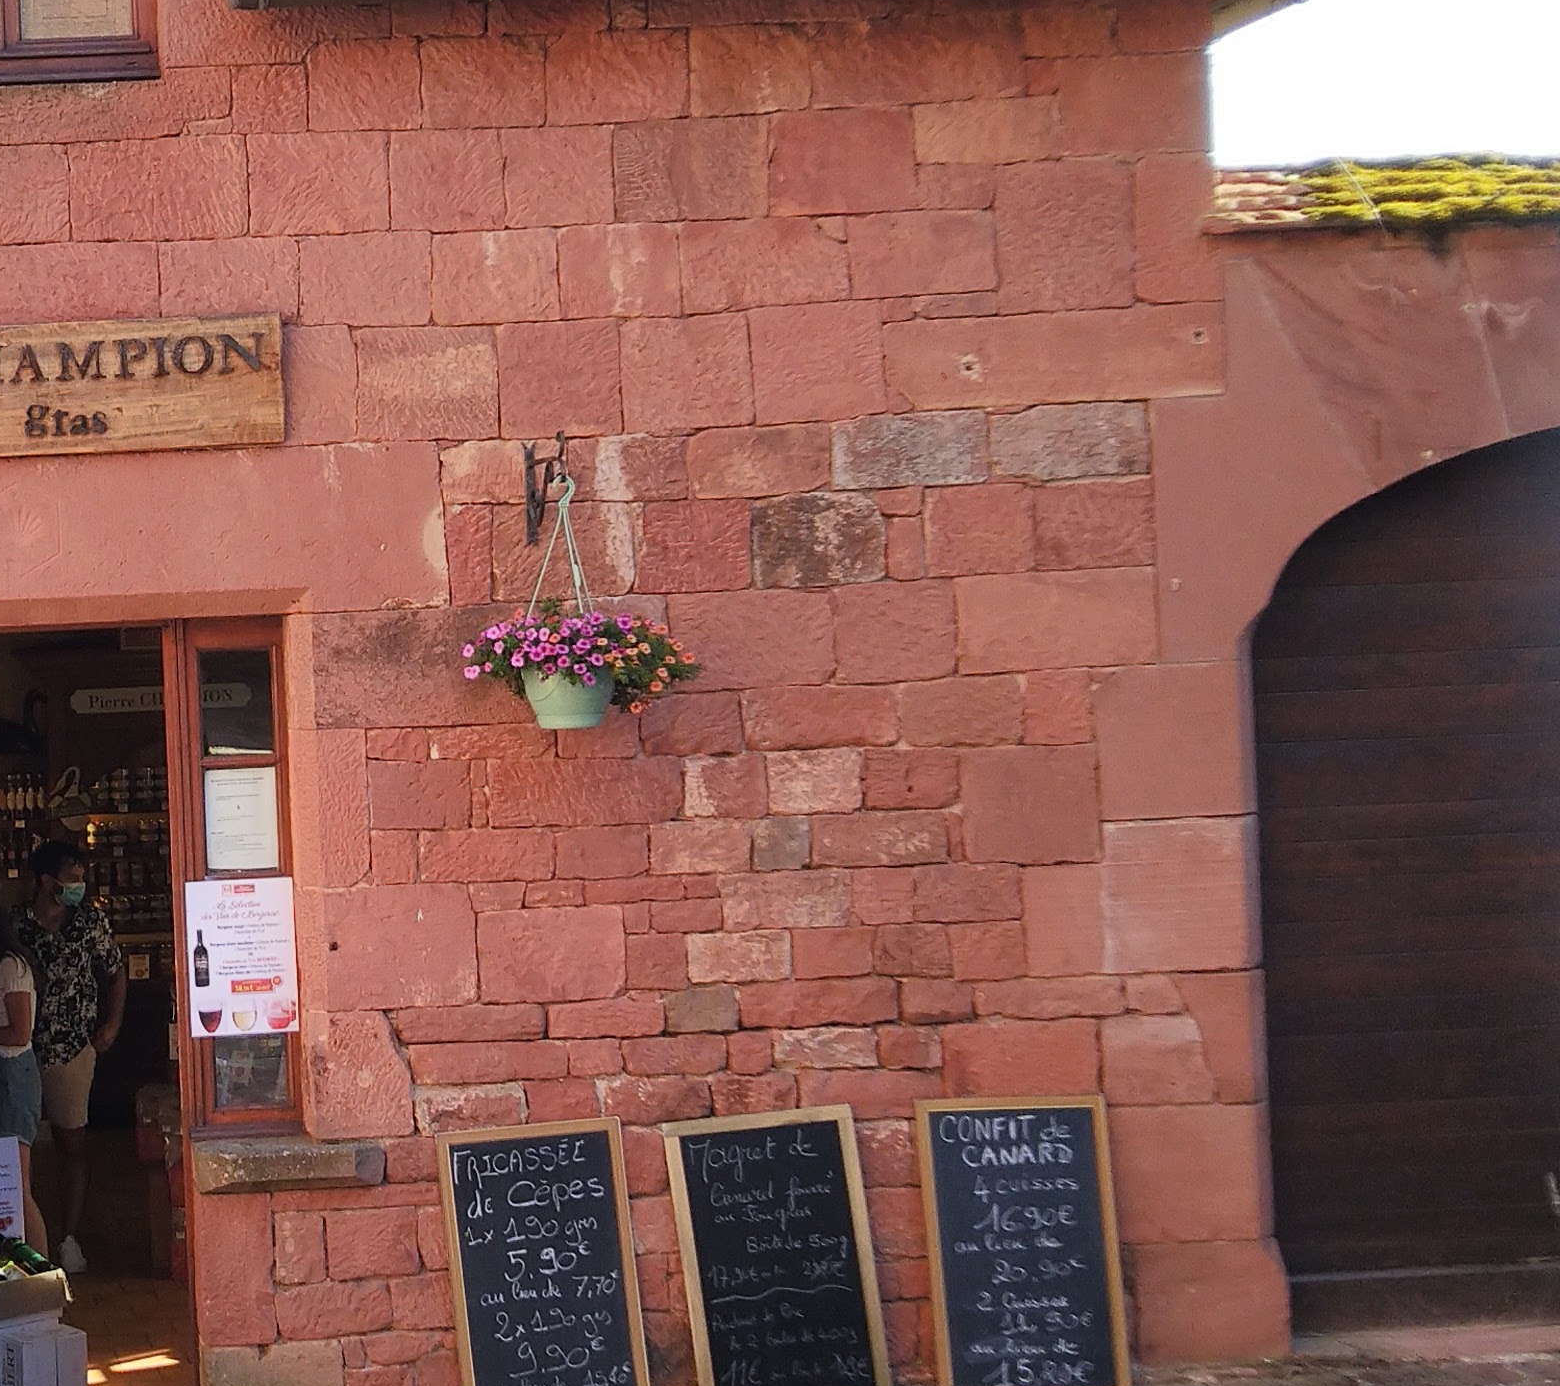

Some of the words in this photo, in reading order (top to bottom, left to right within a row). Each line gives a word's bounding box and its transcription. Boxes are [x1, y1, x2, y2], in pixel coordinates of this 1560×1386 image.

[24, 403, 109, 439] gras
[88, 694, 135, 710] Pierre
[940, 1115, 1037, 1143] CONFIT
[1040, 1116, 1074, 1141] de
[961, 1141, 1075, 1168] CANARD
[995, 1173, 1080, 1195] cuisses
[468, 1189, 494, 1219] de
[503, 1215, 559, 1243] 190
[480, 1292, 506, 1307] au
[511, 1280, 539, 1300] lieu
[542, 1278, 562, 1298] de
